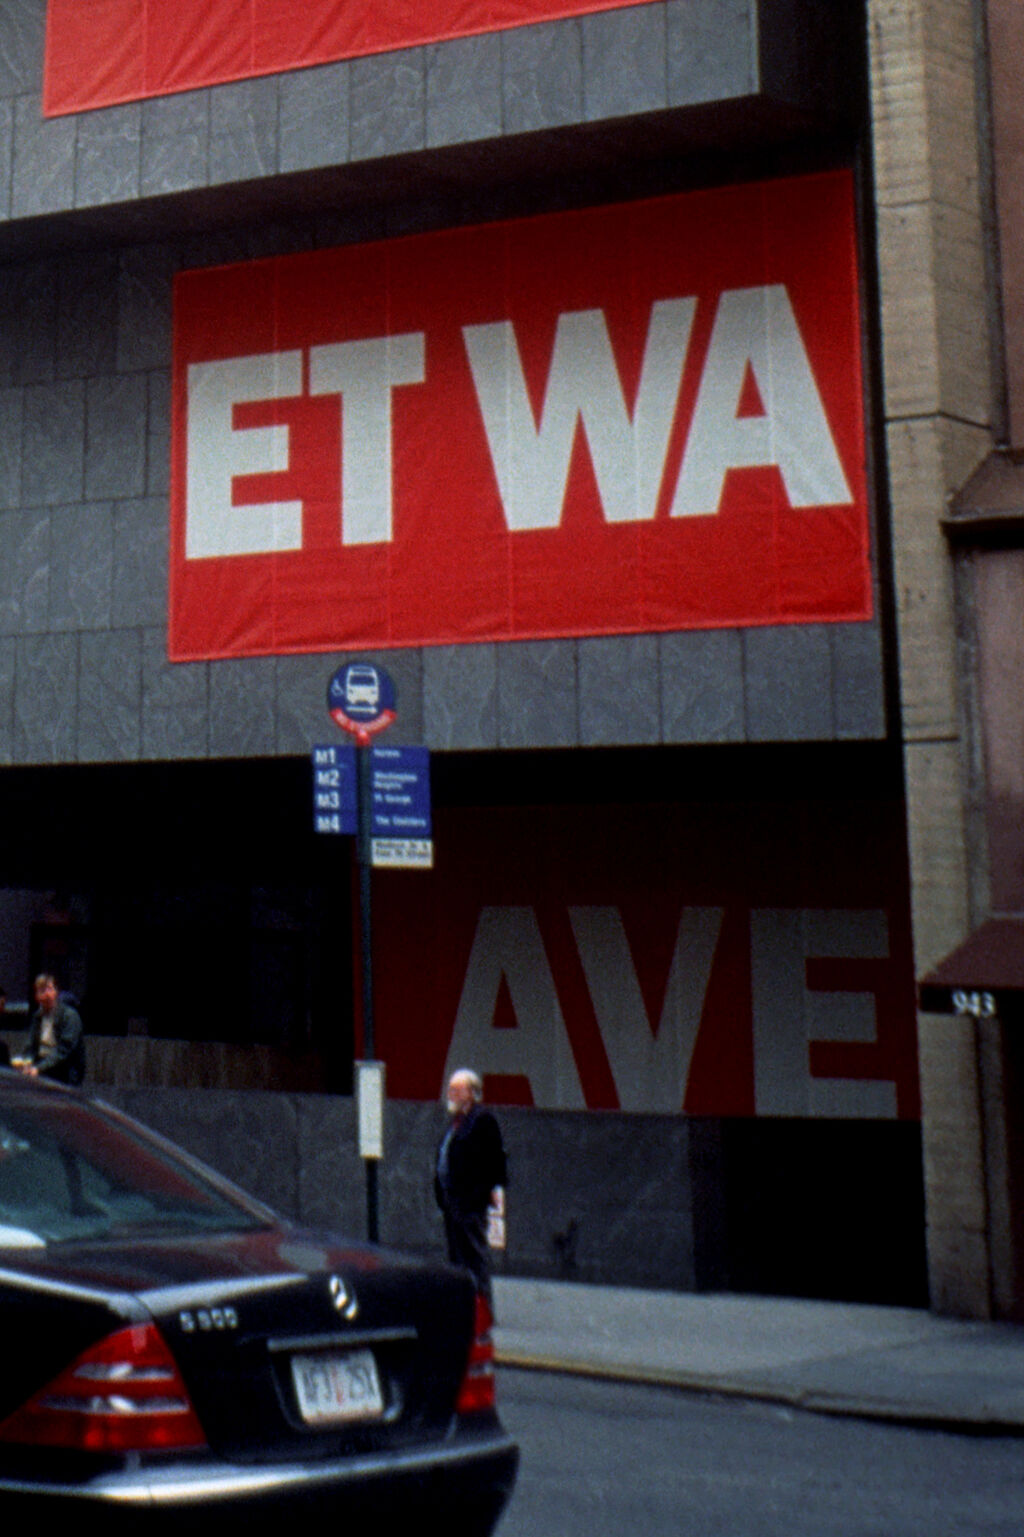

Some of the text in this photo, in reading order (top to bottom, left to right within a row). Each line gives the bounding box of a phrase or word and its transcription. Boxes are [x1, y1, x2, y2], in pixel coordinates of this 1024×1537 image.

[185, 284, 854, 560] ET WA
[315, 747, 336, 764] M1
[317, 768, 339, 786] M2
[317, 791, 339, 809] M3
[317, 814, 339, 833] M4
[442, 905, 898, 1120] AVE
[952, 988, 996, 1018] 943
